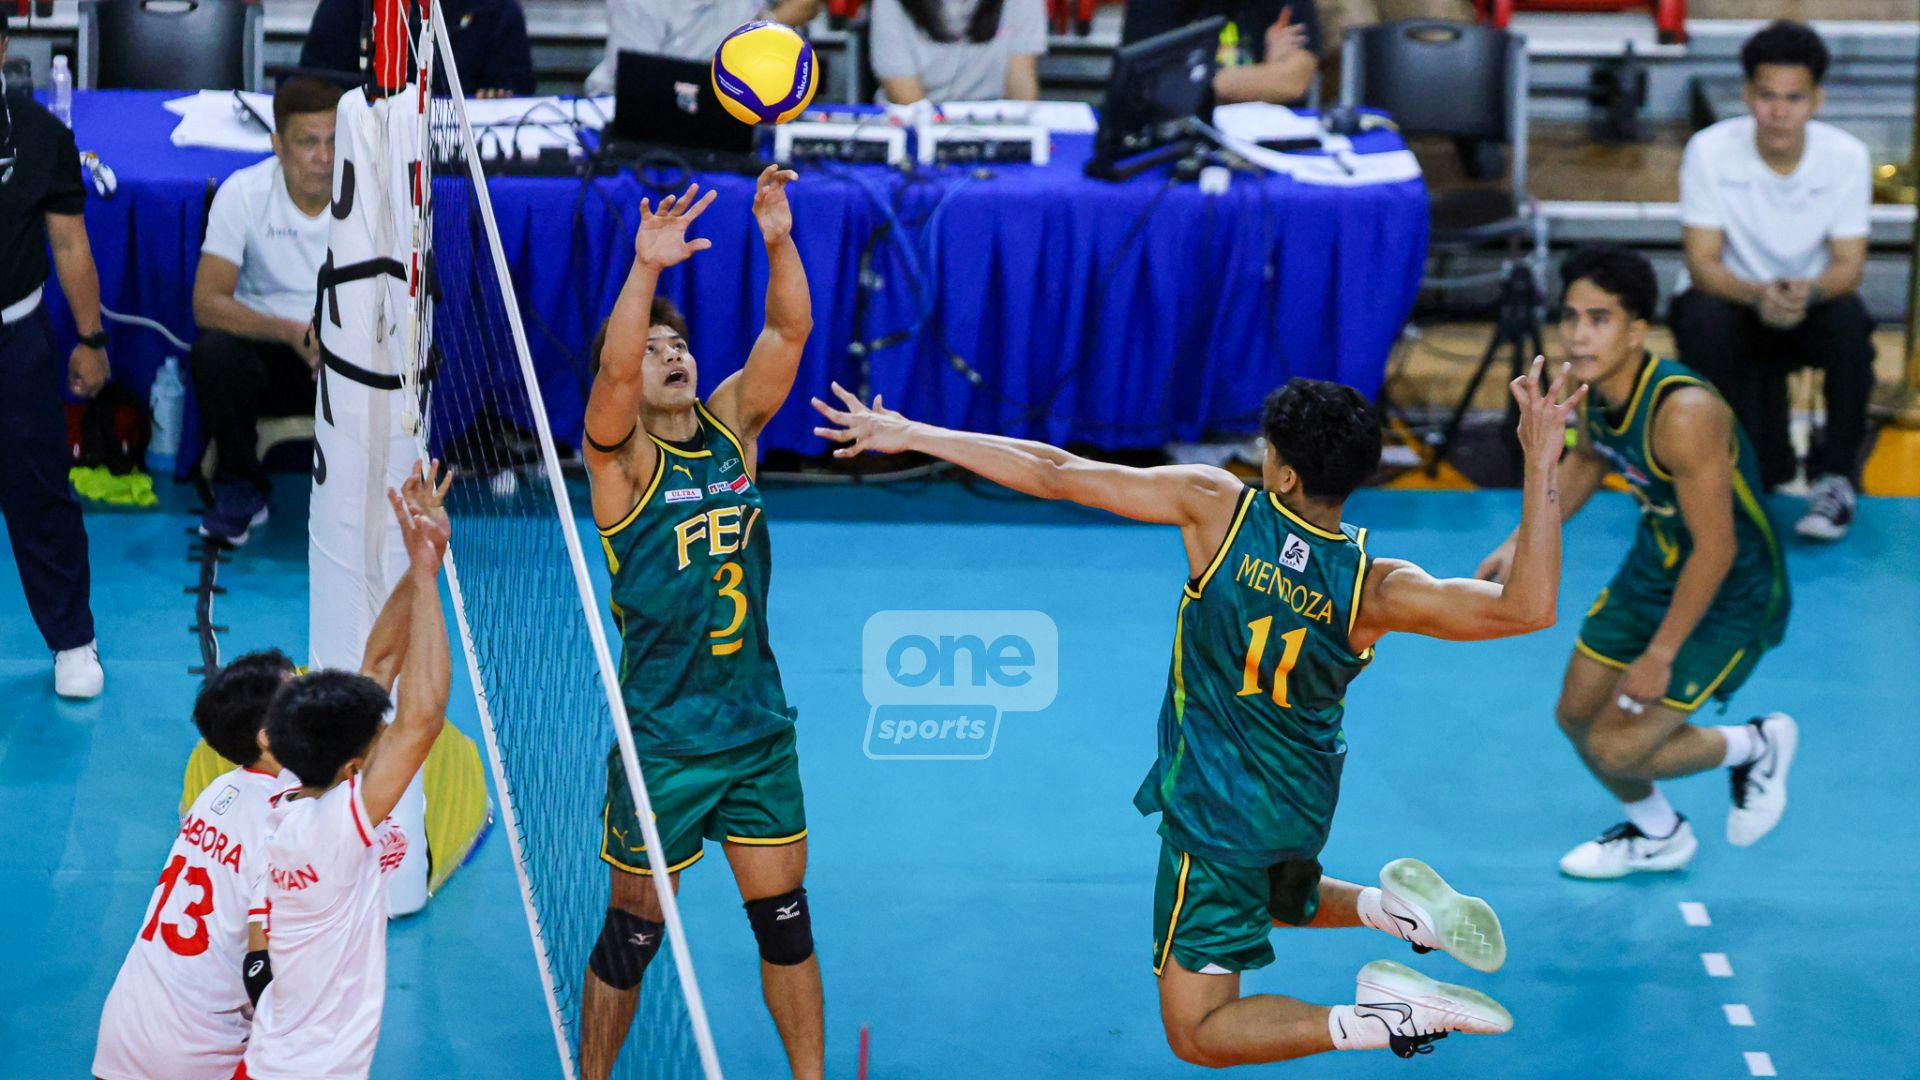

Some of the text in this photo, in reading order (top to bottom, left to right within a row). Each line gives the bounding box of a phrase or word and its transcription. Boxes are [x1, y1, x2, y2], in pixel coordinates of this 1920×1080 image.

[671, 489, 696, 498] ULTRA
[710, 561, 748, 638] 3
[1236, 553, 1333, 625] MENDOZA
[1236, 615, 1307, 708] 11
[141, 854, 215, 956] 13
